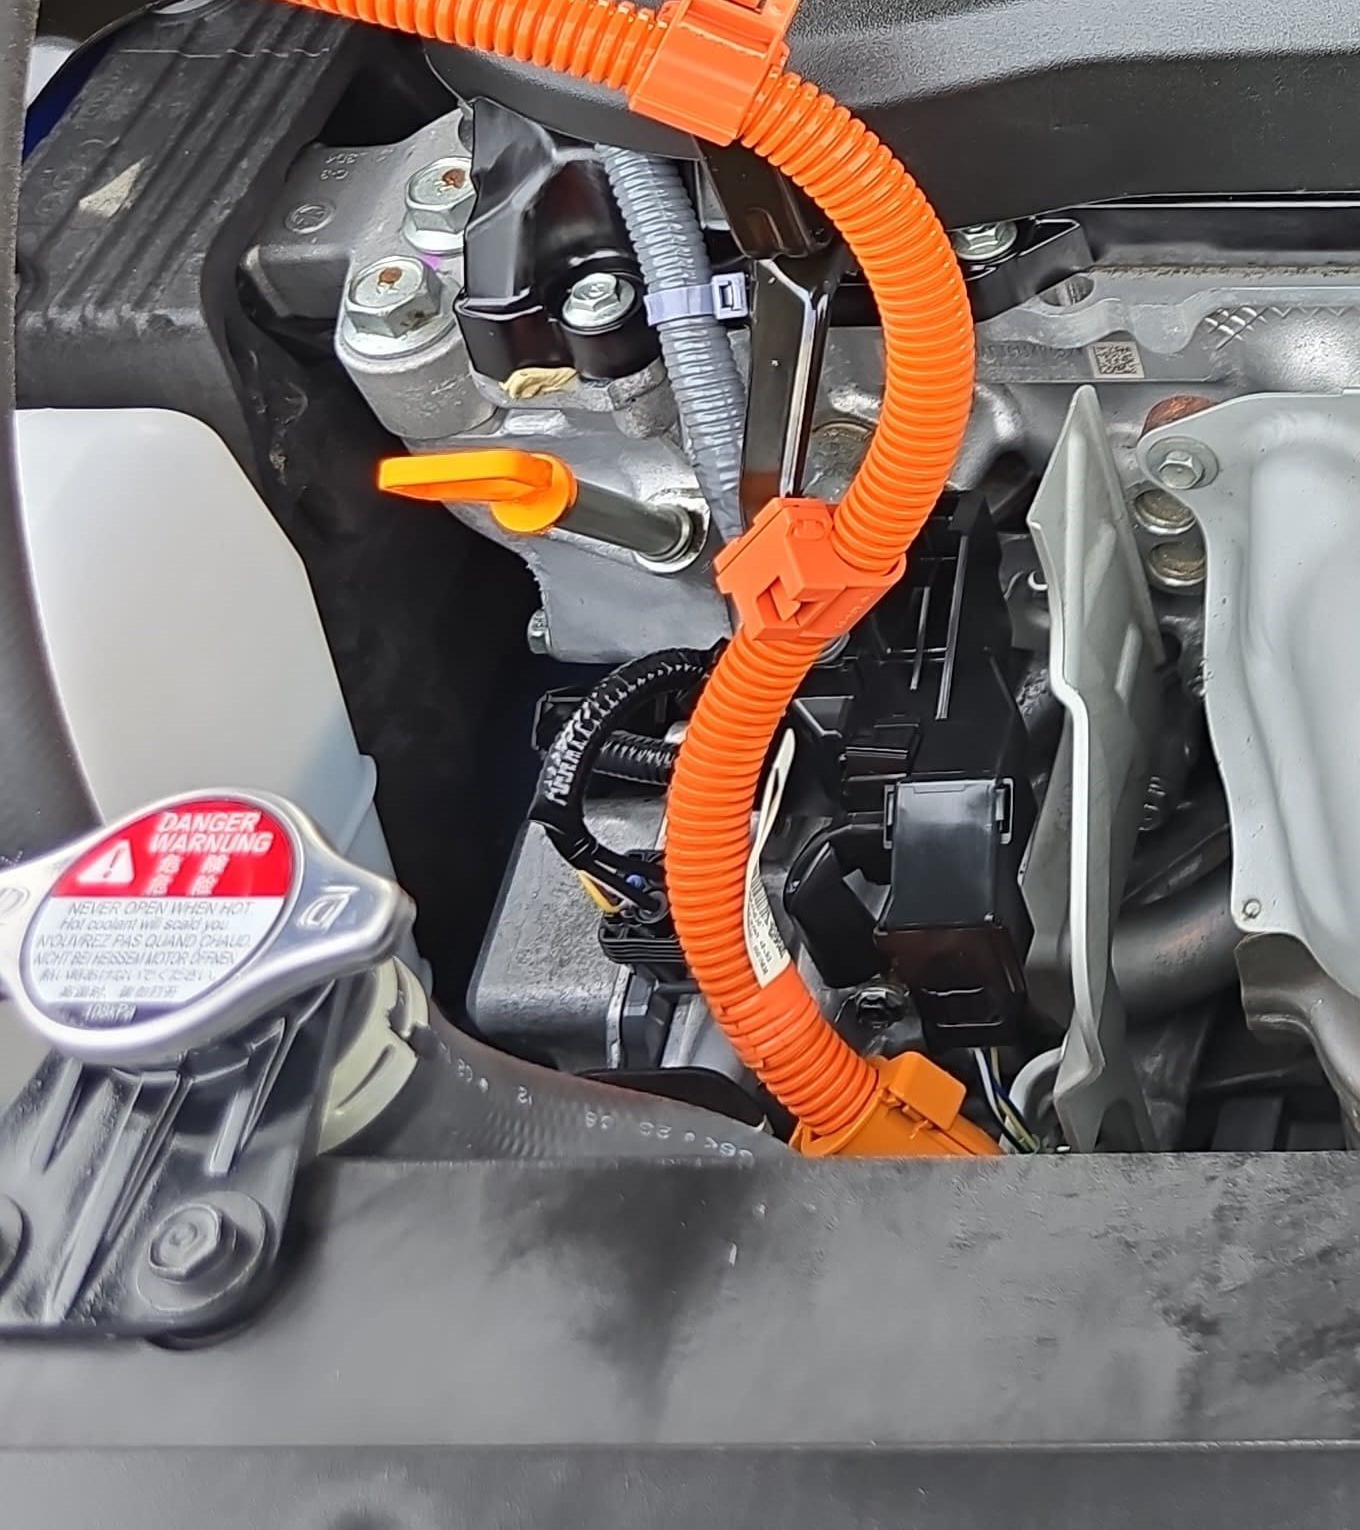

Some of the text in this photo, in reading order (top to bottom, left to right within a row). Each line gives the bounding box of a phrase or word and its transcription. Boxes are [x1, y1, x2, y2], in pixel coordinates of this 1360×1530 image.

[157, 811, 262, 832] DANGER
[149, 831, 274, 855] WARNUNG
[68, 902, 122, 916] NEVER
[124, 902, 169, 916] OPEN
[171, 902, 217, 916] WHEN
